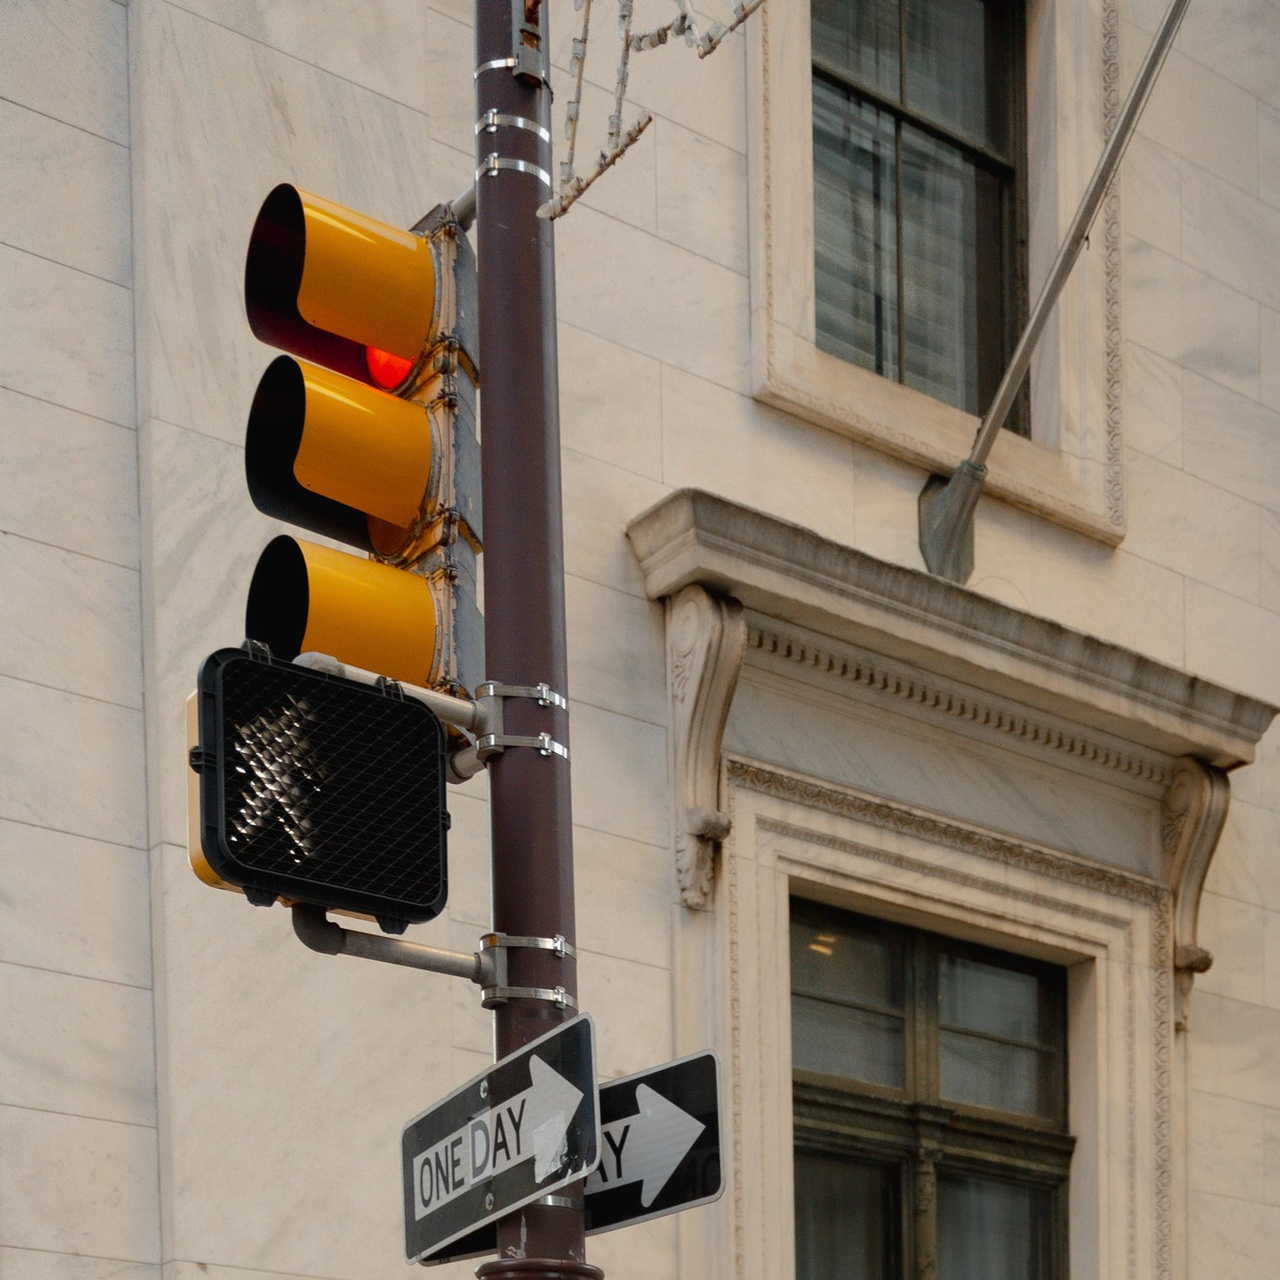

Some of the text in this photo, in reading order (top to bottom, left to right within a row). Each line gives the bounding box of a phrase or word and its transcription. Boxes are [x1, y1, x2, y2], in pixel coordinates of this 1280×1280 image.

[420, 1098, 526, 1208] ONE DAY
[584, 1124, 631, 1188] AY
